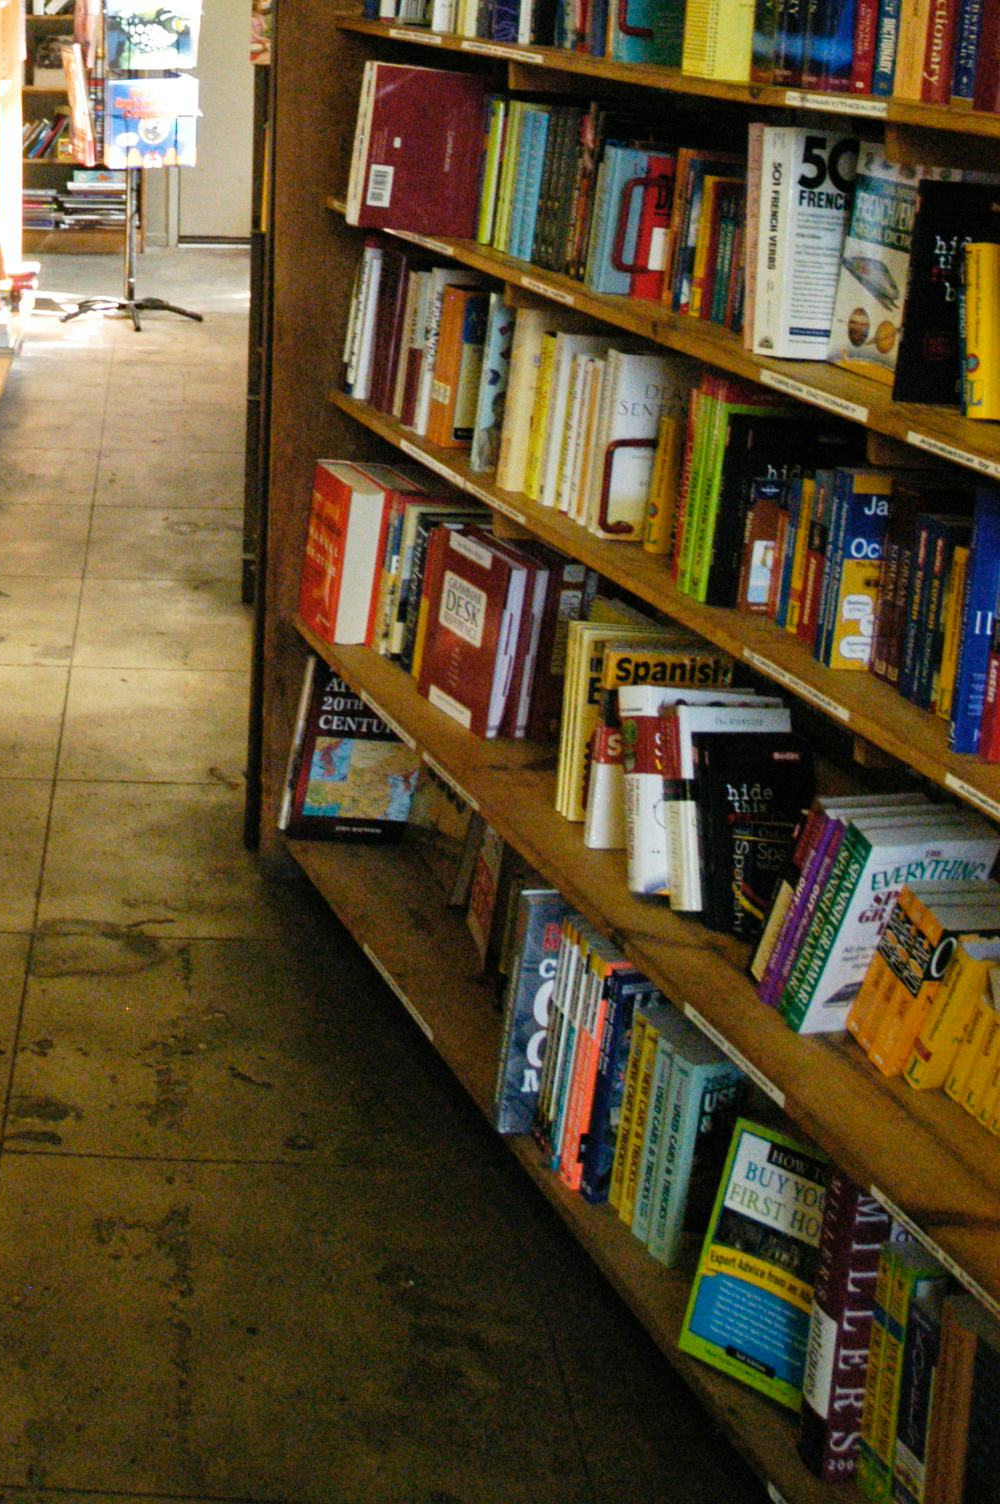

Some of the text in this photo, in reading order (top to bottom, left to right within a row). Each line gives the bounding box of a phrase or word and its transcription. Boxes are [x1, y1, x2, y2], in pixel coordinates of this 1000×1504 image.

[881, 18, 897, 75] DICTIONARY
[767, 162, 783, 271] 501 FRENCH VERBS
[444, 588, 482, 628] DESK
[909, 570, 926, 621] Korean
[926, 579, 942, 630] Korean
[727, 783, 773, 801] hide
[804, 883, 822, 912] OUT
[818, 848, 851, 912] SPANISH
[828, 860, 863, 925] SPANISH
[626, 1085, 635, 1113] CARS
[641, 1072, 651, 1097] NEW
[654, 1085, 665, 1114] USED
[637, 1100, 647, 1127] CARS
[649, 1117, 660, 1145] CARS
[671, 1104, 682, 1133] USED
[617, 1127, 629, 1167] TRUCKS
[628, 1143, 640, 1183] TRUCKS
[666, 1135, 678, 1164] CARS
[641, 1159, 656, 1200] TRUCKS
[746, 1160, 788, 1194] BUY
[658, 1178, 673, 1222] TRUCKS
[730, 1183, 790, 1222] FIRST
[709, 1250, 738, 1271] Expert
[738, 1258, 767, 1278] Advice
[767, 1268, 786, 1284] from
[829, 1195, 890, 1452] MILLER'S
[805, 1309, 826, 1398] antiques
